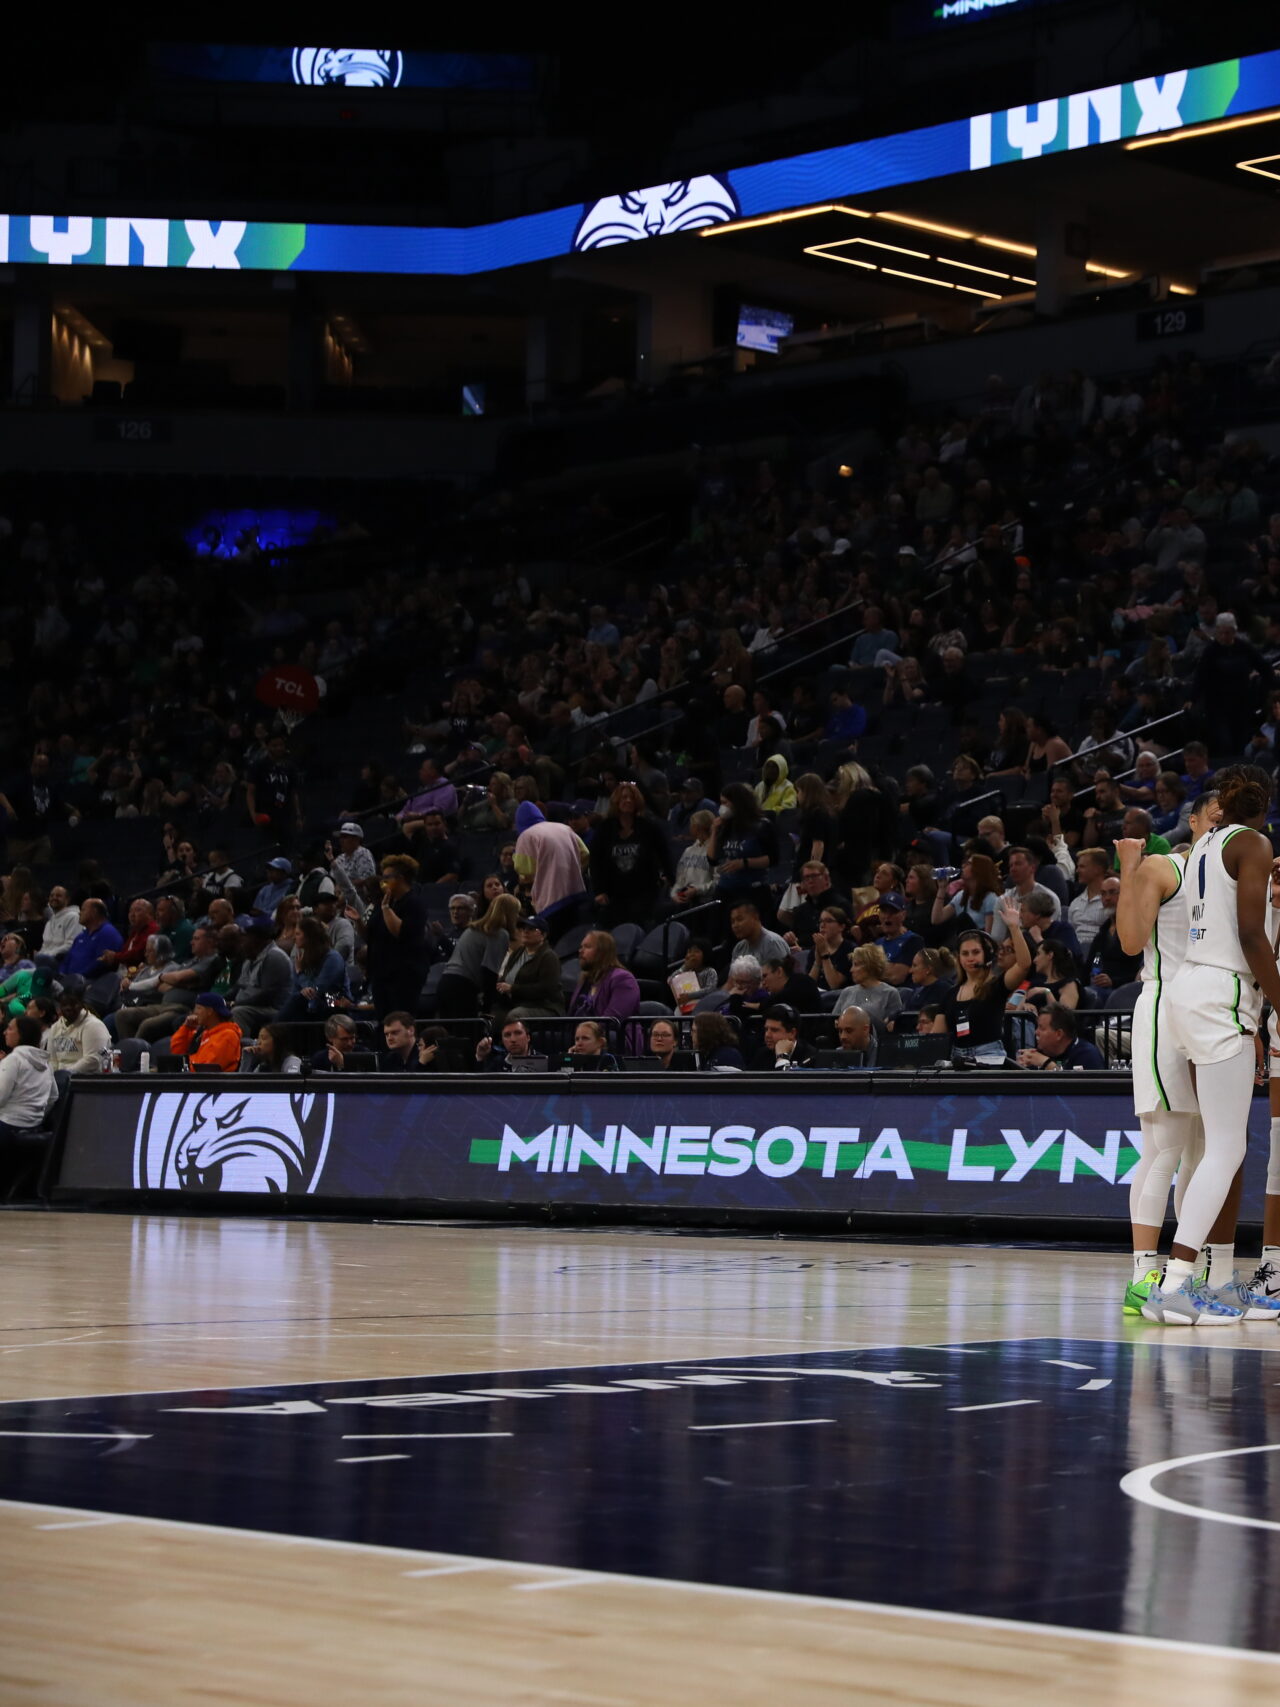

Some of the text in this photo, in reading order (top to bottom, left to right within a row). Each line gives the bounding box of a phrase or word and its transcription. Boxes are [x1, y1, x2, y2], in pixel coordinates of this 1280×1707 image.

[1153, 311, 1188, 335] 129
[118, 420, 153, 440] 126
[274, 677, 305, 697] TCL
[1198, 854, 1206, 899] 1
[498, 1124, 914, 1180] MINNESOTA
